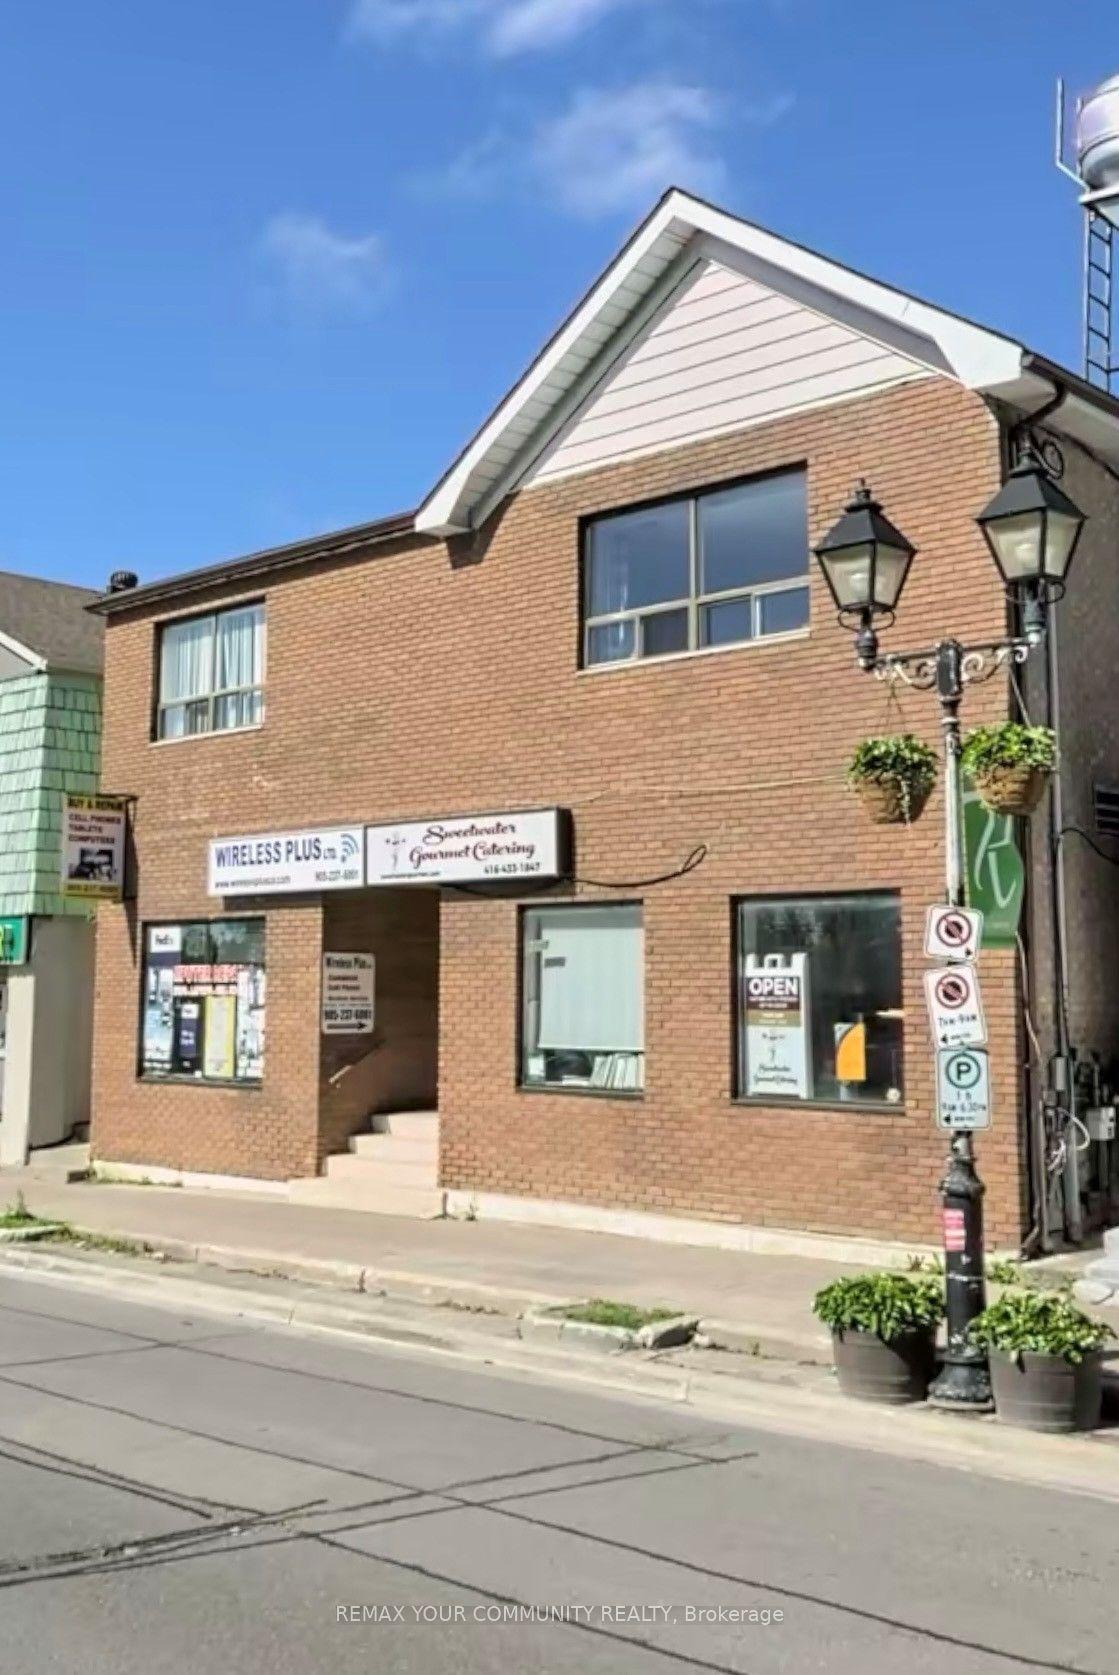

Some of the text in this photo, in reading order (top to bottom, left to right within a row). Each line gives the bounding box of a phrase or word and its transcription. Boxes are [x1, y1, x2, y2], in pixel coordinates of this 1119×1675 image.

[423, 822, 516, 845] Sweetwater
[215, 841, 281, 867] WIRELESS
[286, 837, 321, 863] PLUS
[409, 841, 535, 869] Gourmet Catering
[749, 978, 799, 996] OPEN
[956, 1062, 972, 1081] P
